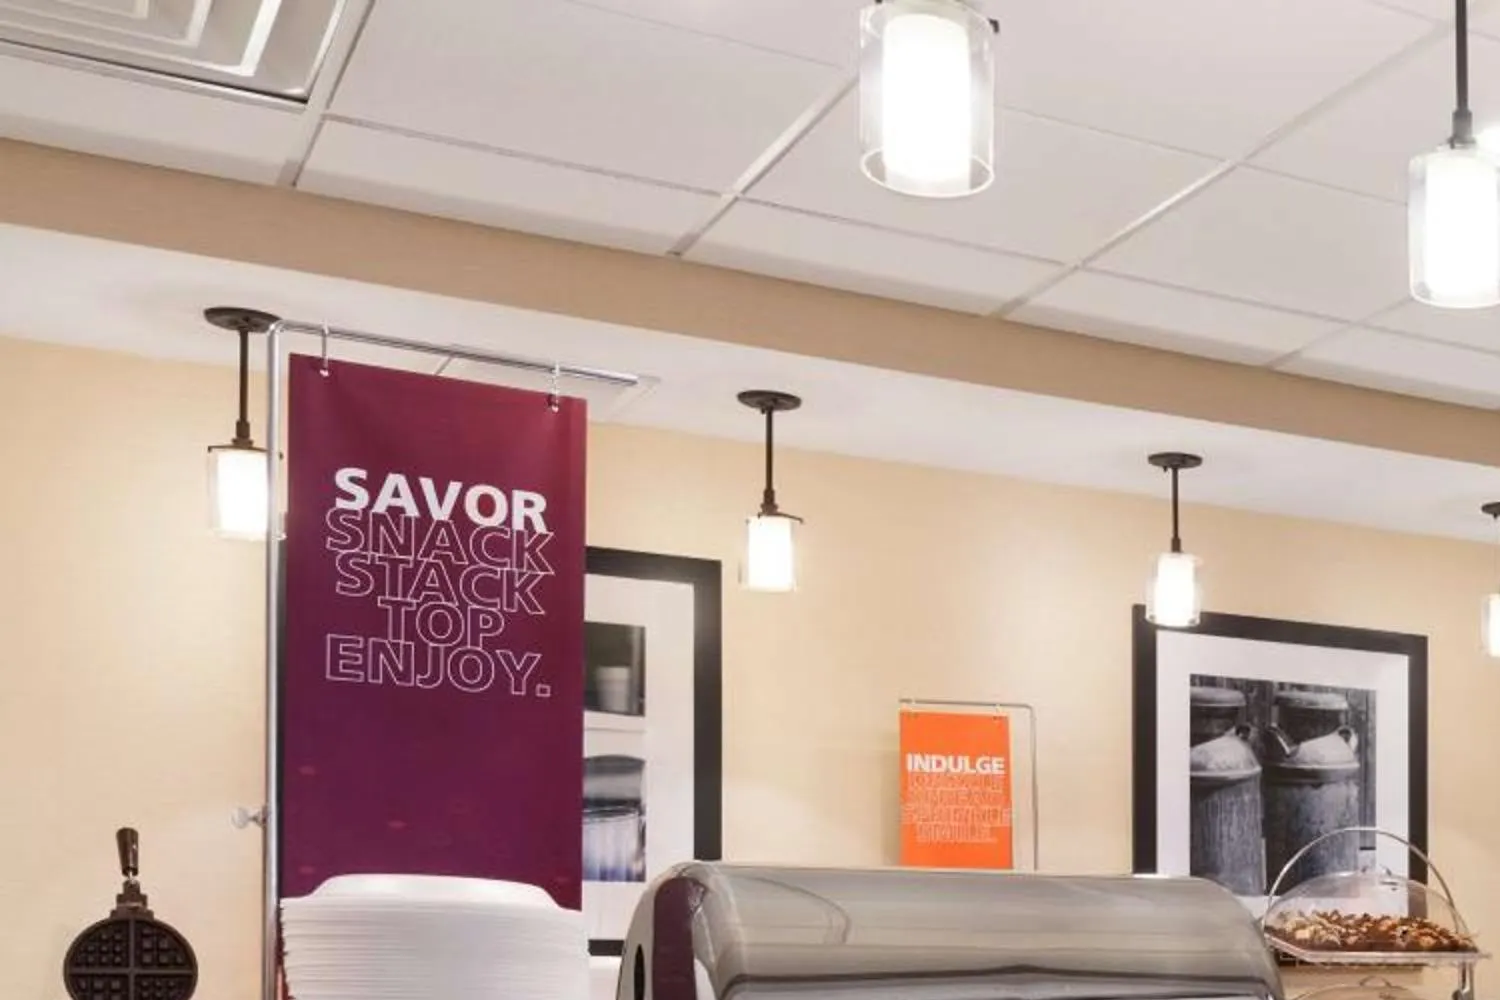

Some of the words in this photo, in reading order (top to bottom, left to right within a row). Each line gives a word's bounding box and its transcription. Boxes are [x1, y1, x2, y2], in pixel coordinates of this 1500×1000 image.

[334, 467, 548, 534] SAVOR
[325, 506, 556, 576] SNACK
[335, 551, 546, 616] STACK
[377, 596, 506, 651] TOP
[325, 634, 552, 698] ENJOY.
[906, 752, 1006, 775] INDULGE
